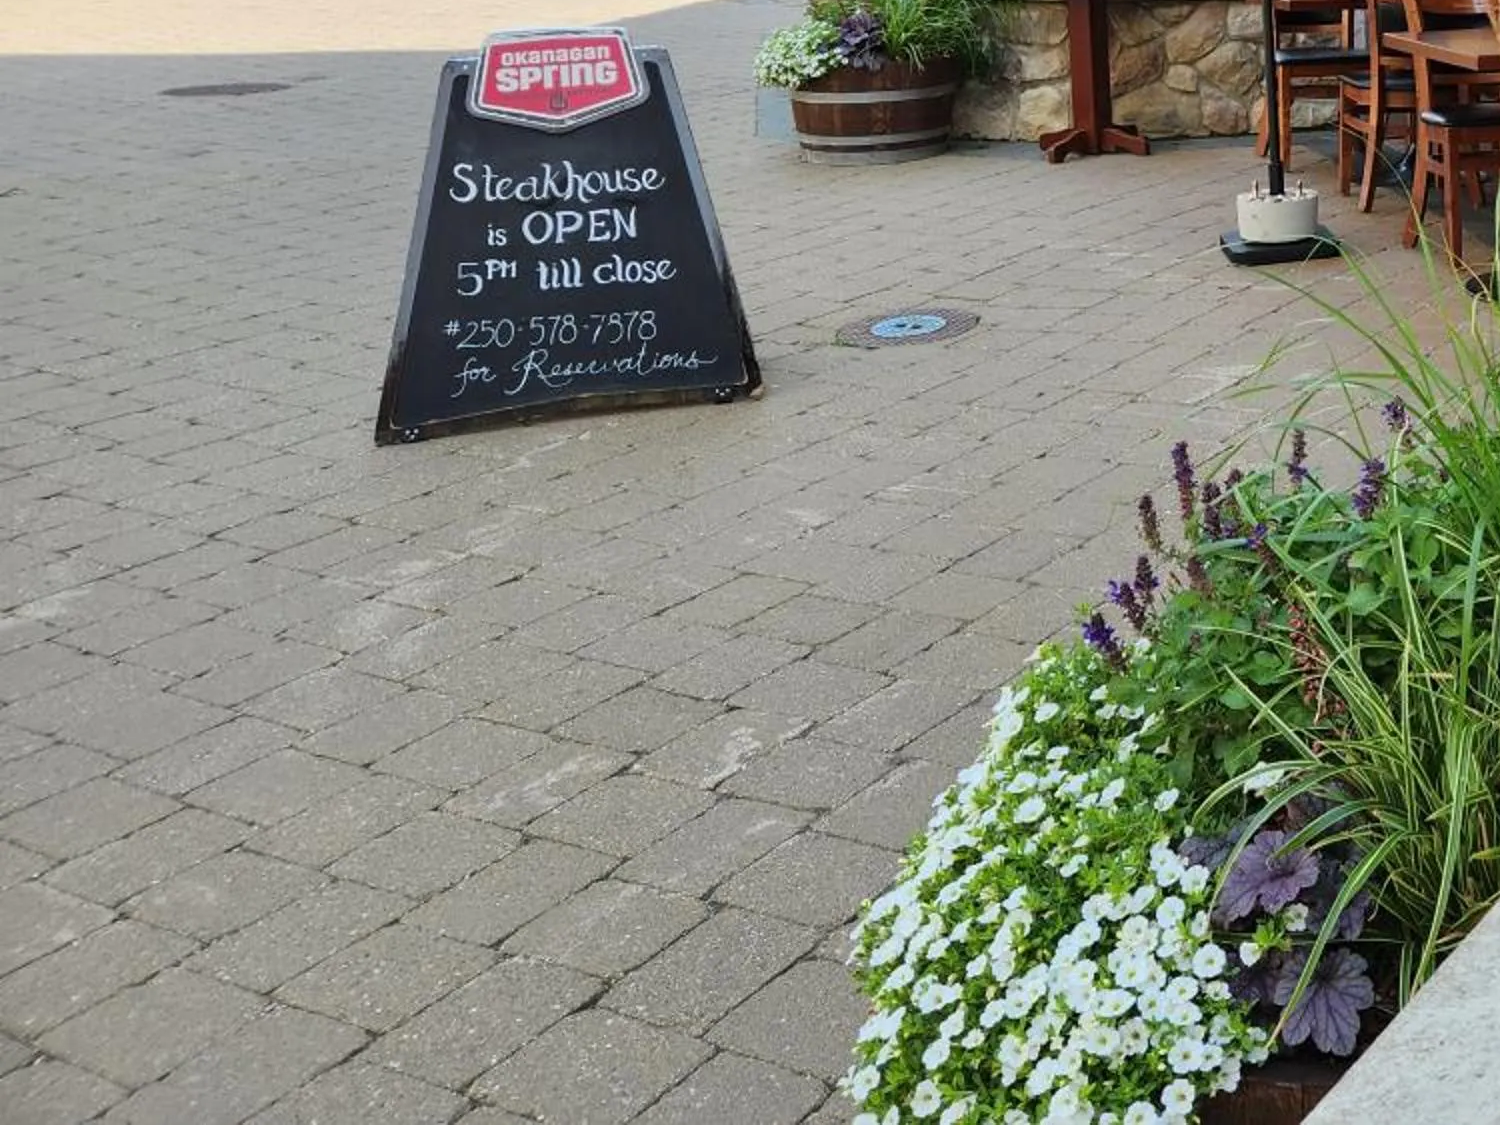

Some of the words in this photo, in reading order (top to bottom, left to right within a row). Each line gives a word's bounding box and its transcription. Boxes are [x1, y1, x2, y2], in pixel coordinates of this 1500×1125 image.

[449, 160, 666, 204] Steakhouse
[487, 223, 507, 246] is
[522, 206, 637, 245] OPEN
[536, 258, 585, 291] till
[593, 254, 677, 285] close
[450, 357, 496, 398] for
[504, 341, 719, 395] Reservations
